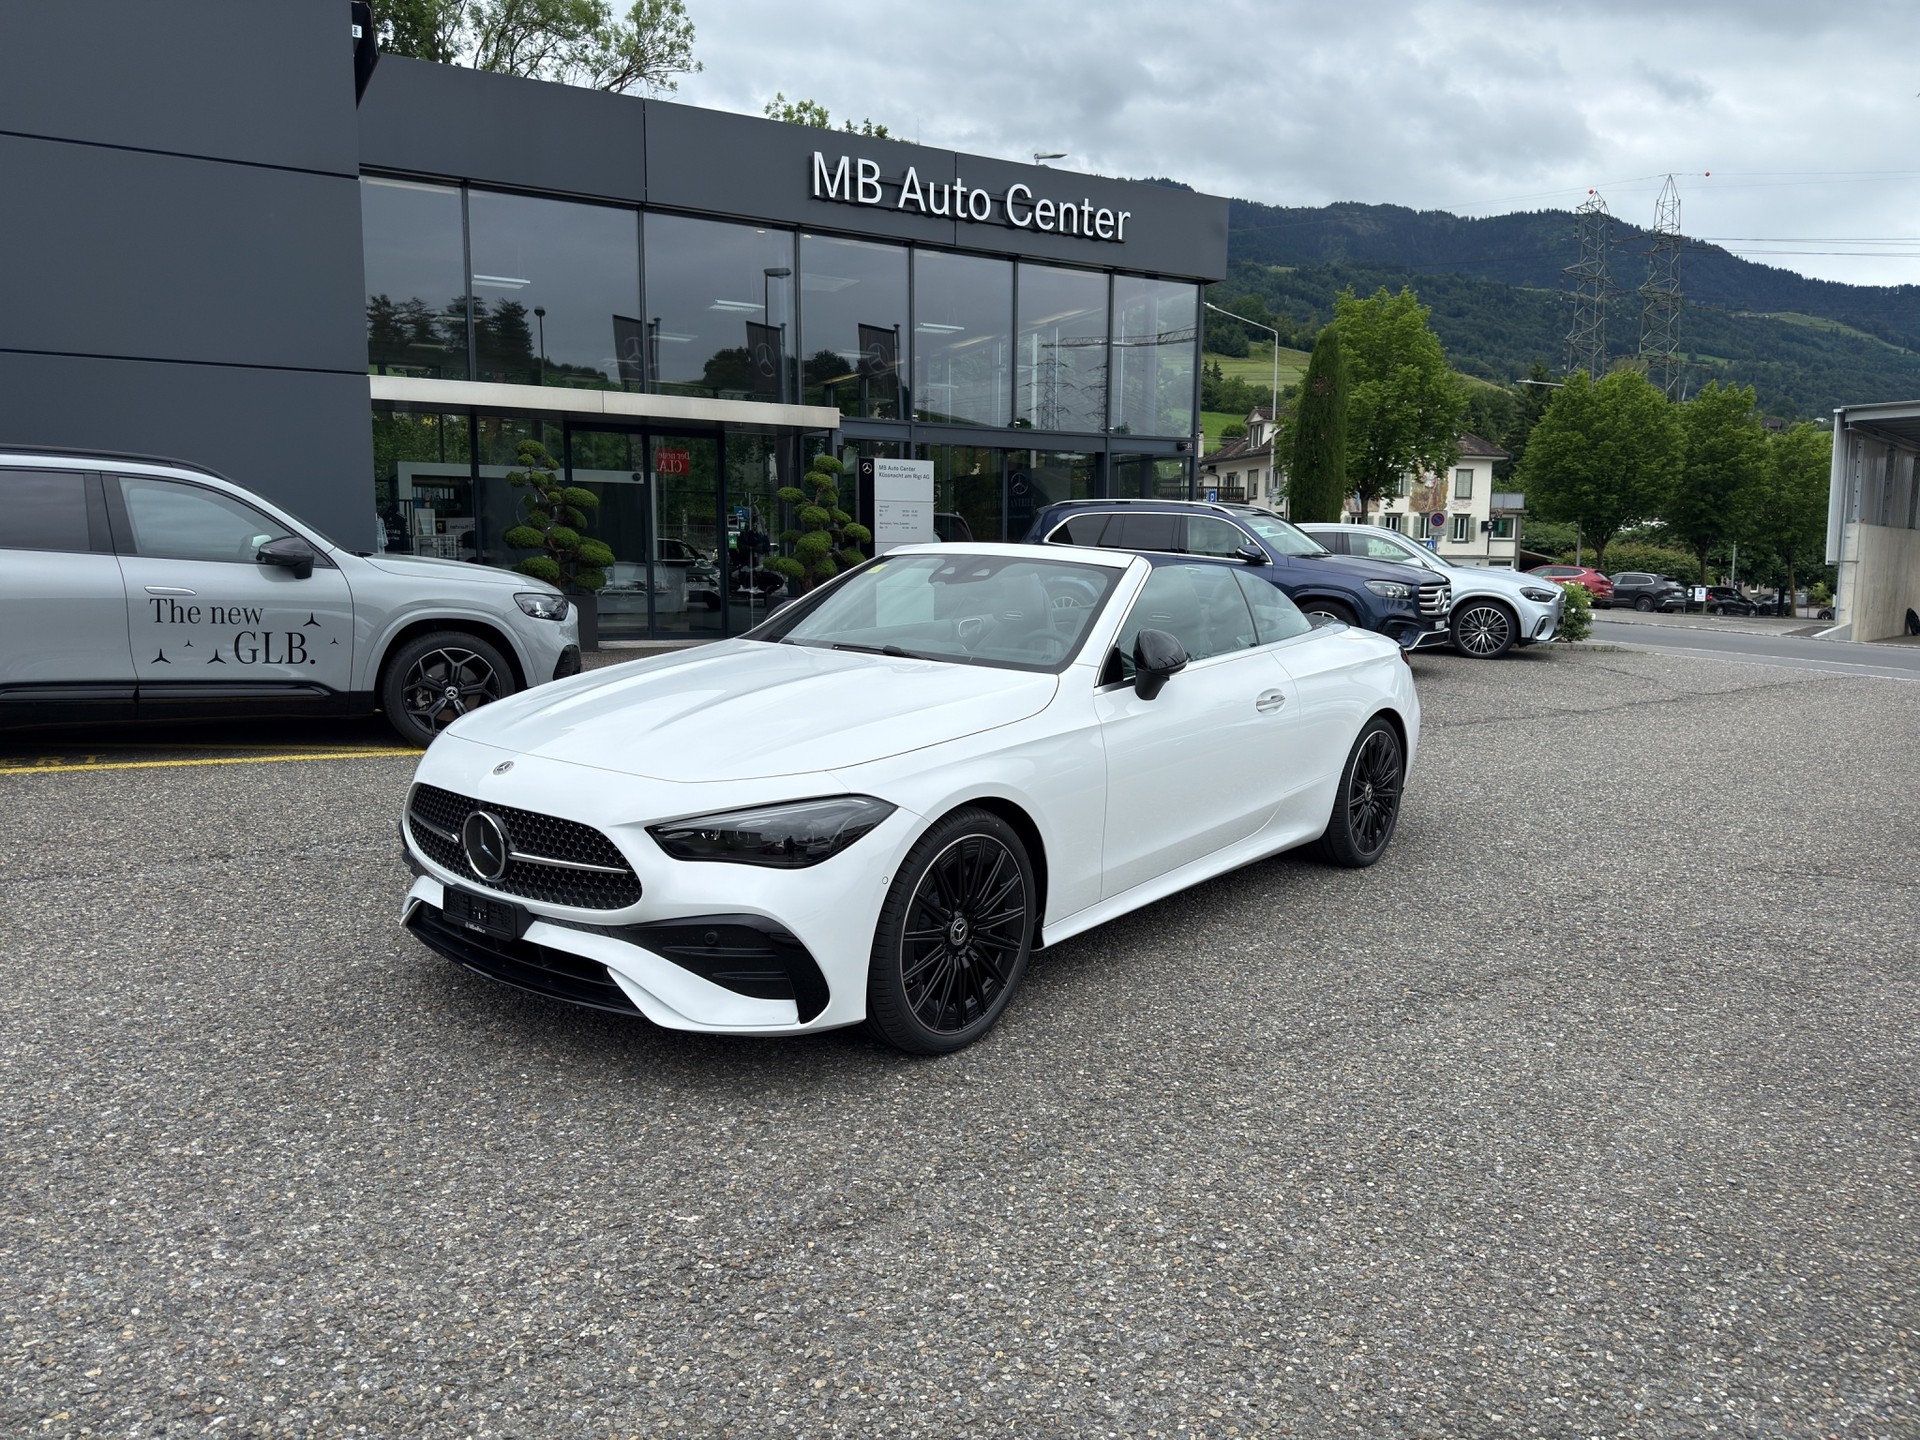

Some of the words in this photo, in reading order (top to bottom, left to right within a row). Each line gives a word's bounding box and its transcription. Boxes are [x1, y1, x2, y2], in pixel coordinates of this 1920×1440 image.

[813, 151, 882, 204] MB
[898, 166, 992, 221] Auto
[1005, 183, 1131, 240] Center
[150, 598, 201, 625] The
[210, 605, 264, 625] new
[233, 630, 316, 665] GLB.
